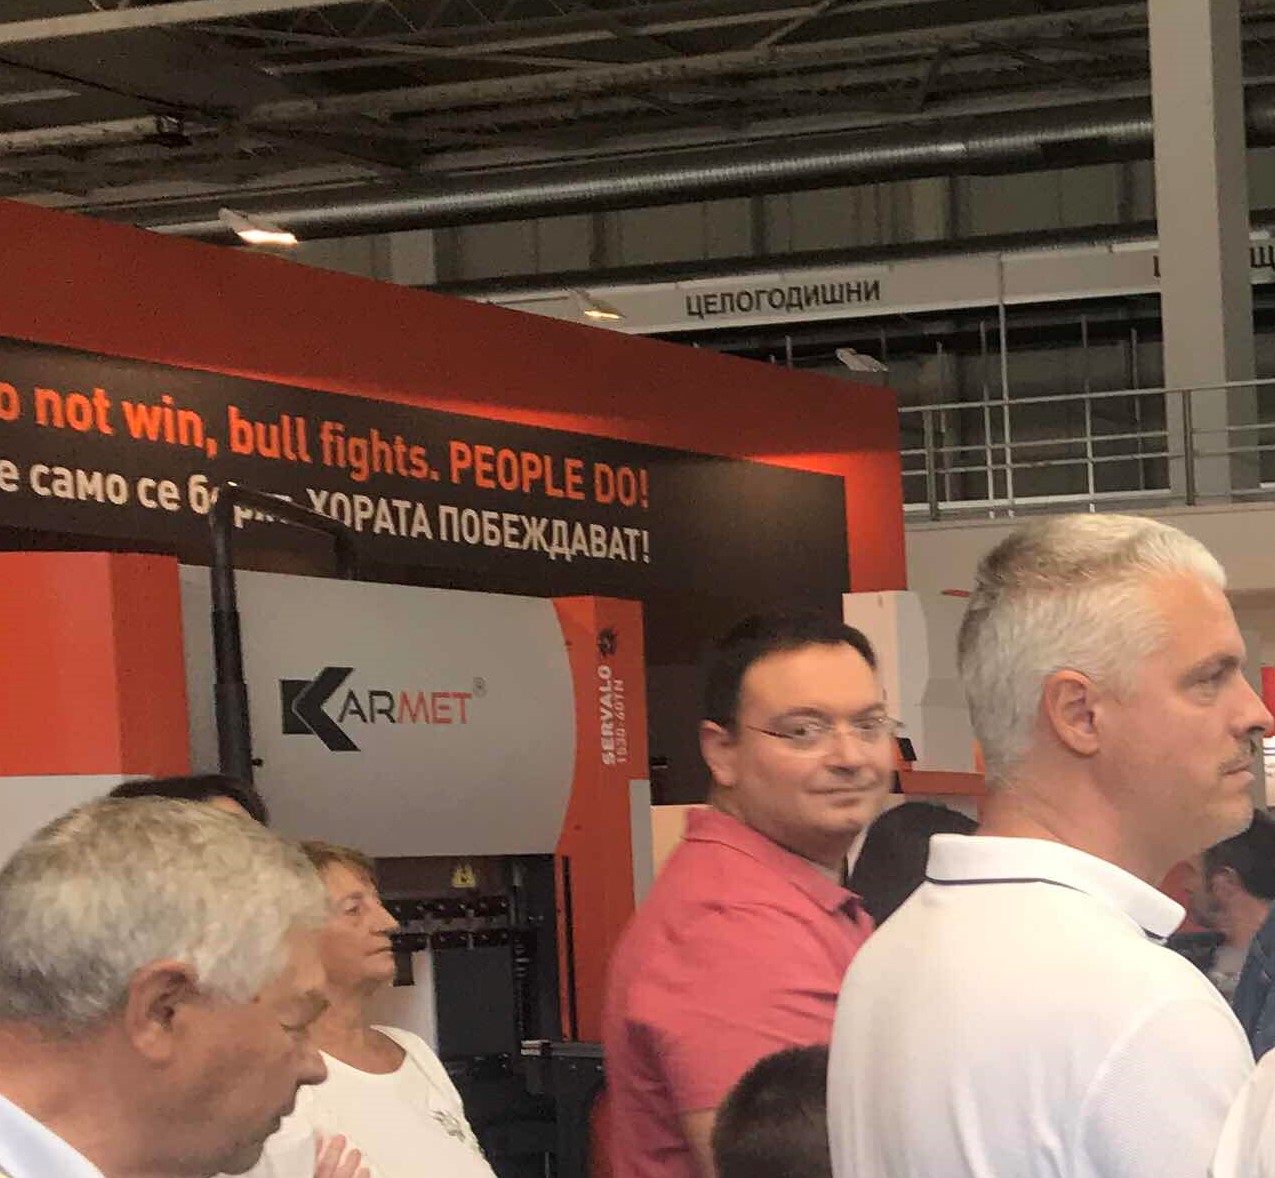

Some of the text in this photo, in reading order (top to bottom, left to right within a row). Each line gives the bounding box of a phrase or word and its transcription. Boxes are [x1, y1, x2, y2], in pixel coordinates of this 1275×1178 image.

[686, 280, 880, 319] ЦЕЛОГОДИШНИ
[34, 387, 113, 435] not
[121, 394, 218, 459] win,
[228, 405, 312, 463] bull
[319, 420, 439, 482] fights.
[450, 440, 586, 500] PEOPLE
[594, 461, 649, 508] DO!
[29, 462, 128, 506] само
[137, 477, 181, 511] се
[439, 505, 650, 563] ПОБЕЖДАВАТ!
[597, 665, 616, 765] SERVALO
